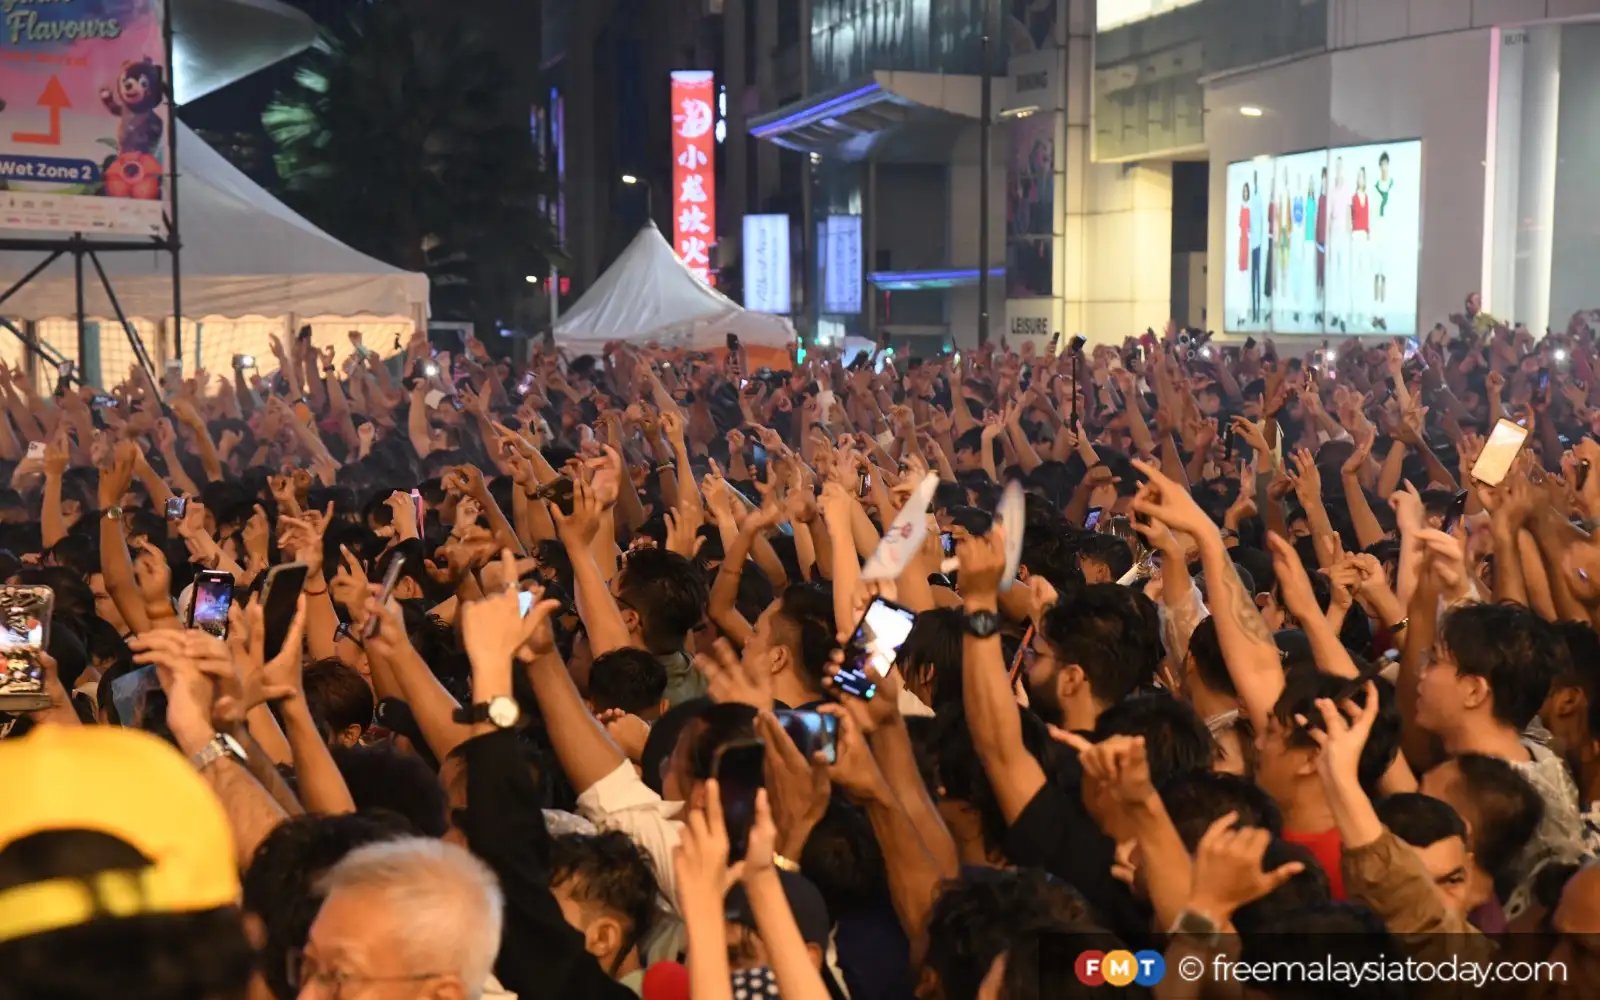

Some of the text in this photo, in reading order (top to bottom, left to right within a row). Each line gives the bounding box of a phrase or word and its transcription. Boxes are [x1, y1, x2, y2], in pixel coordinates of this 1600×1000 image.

[6, 9, 121, 44] Flavours
[0, 160, 93, 180] Wet Zone 2
[1011, 316, 1048, 335] LEISURE
